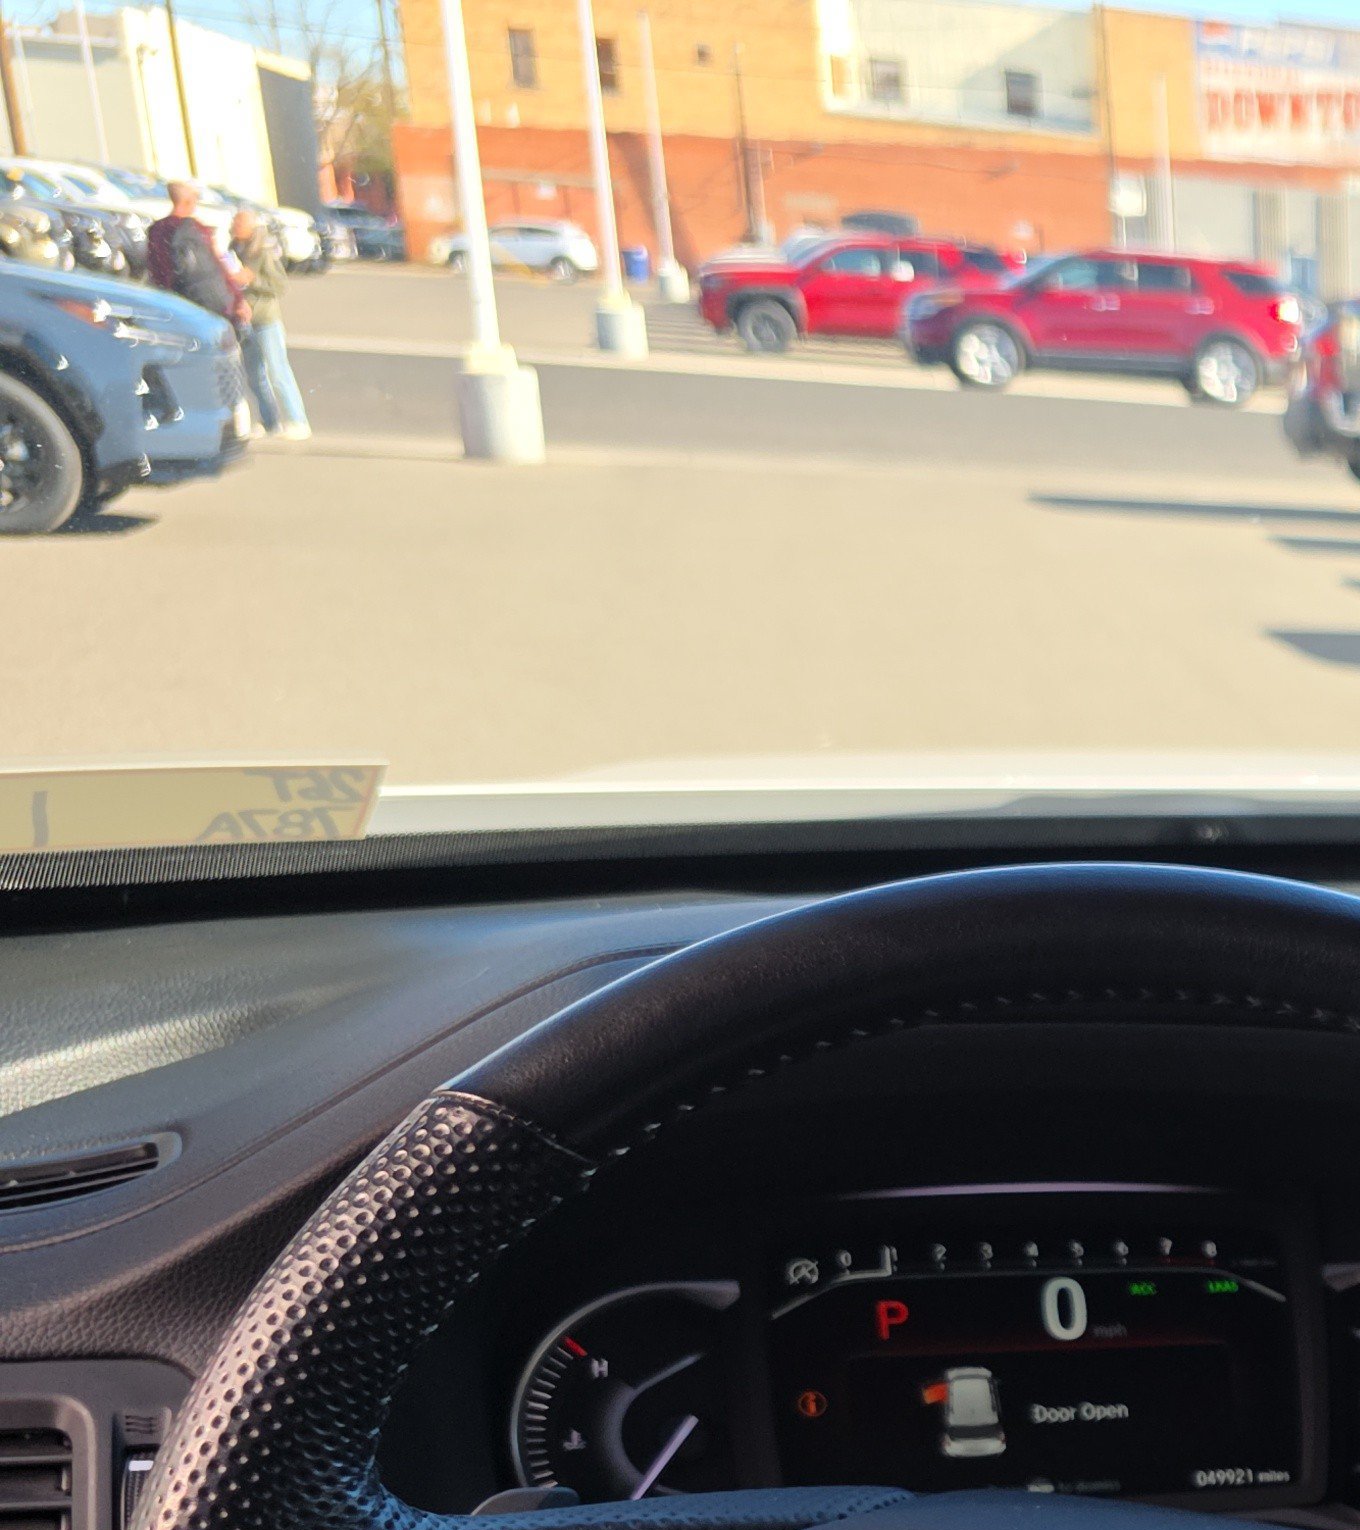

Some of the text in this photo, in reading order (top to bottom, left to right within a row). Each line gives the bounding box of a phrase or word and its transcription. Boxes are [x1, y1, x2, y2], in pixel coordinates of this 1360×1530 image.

[875, 1299, 910, 1341] P
[1041, 1276, 1088, 1341] 0
[590, 1358, 609, 1378] H
[1031, 1400, 1130, 1424] Door Open
[1195, 1467, 1291, 1489] 049921 miles
